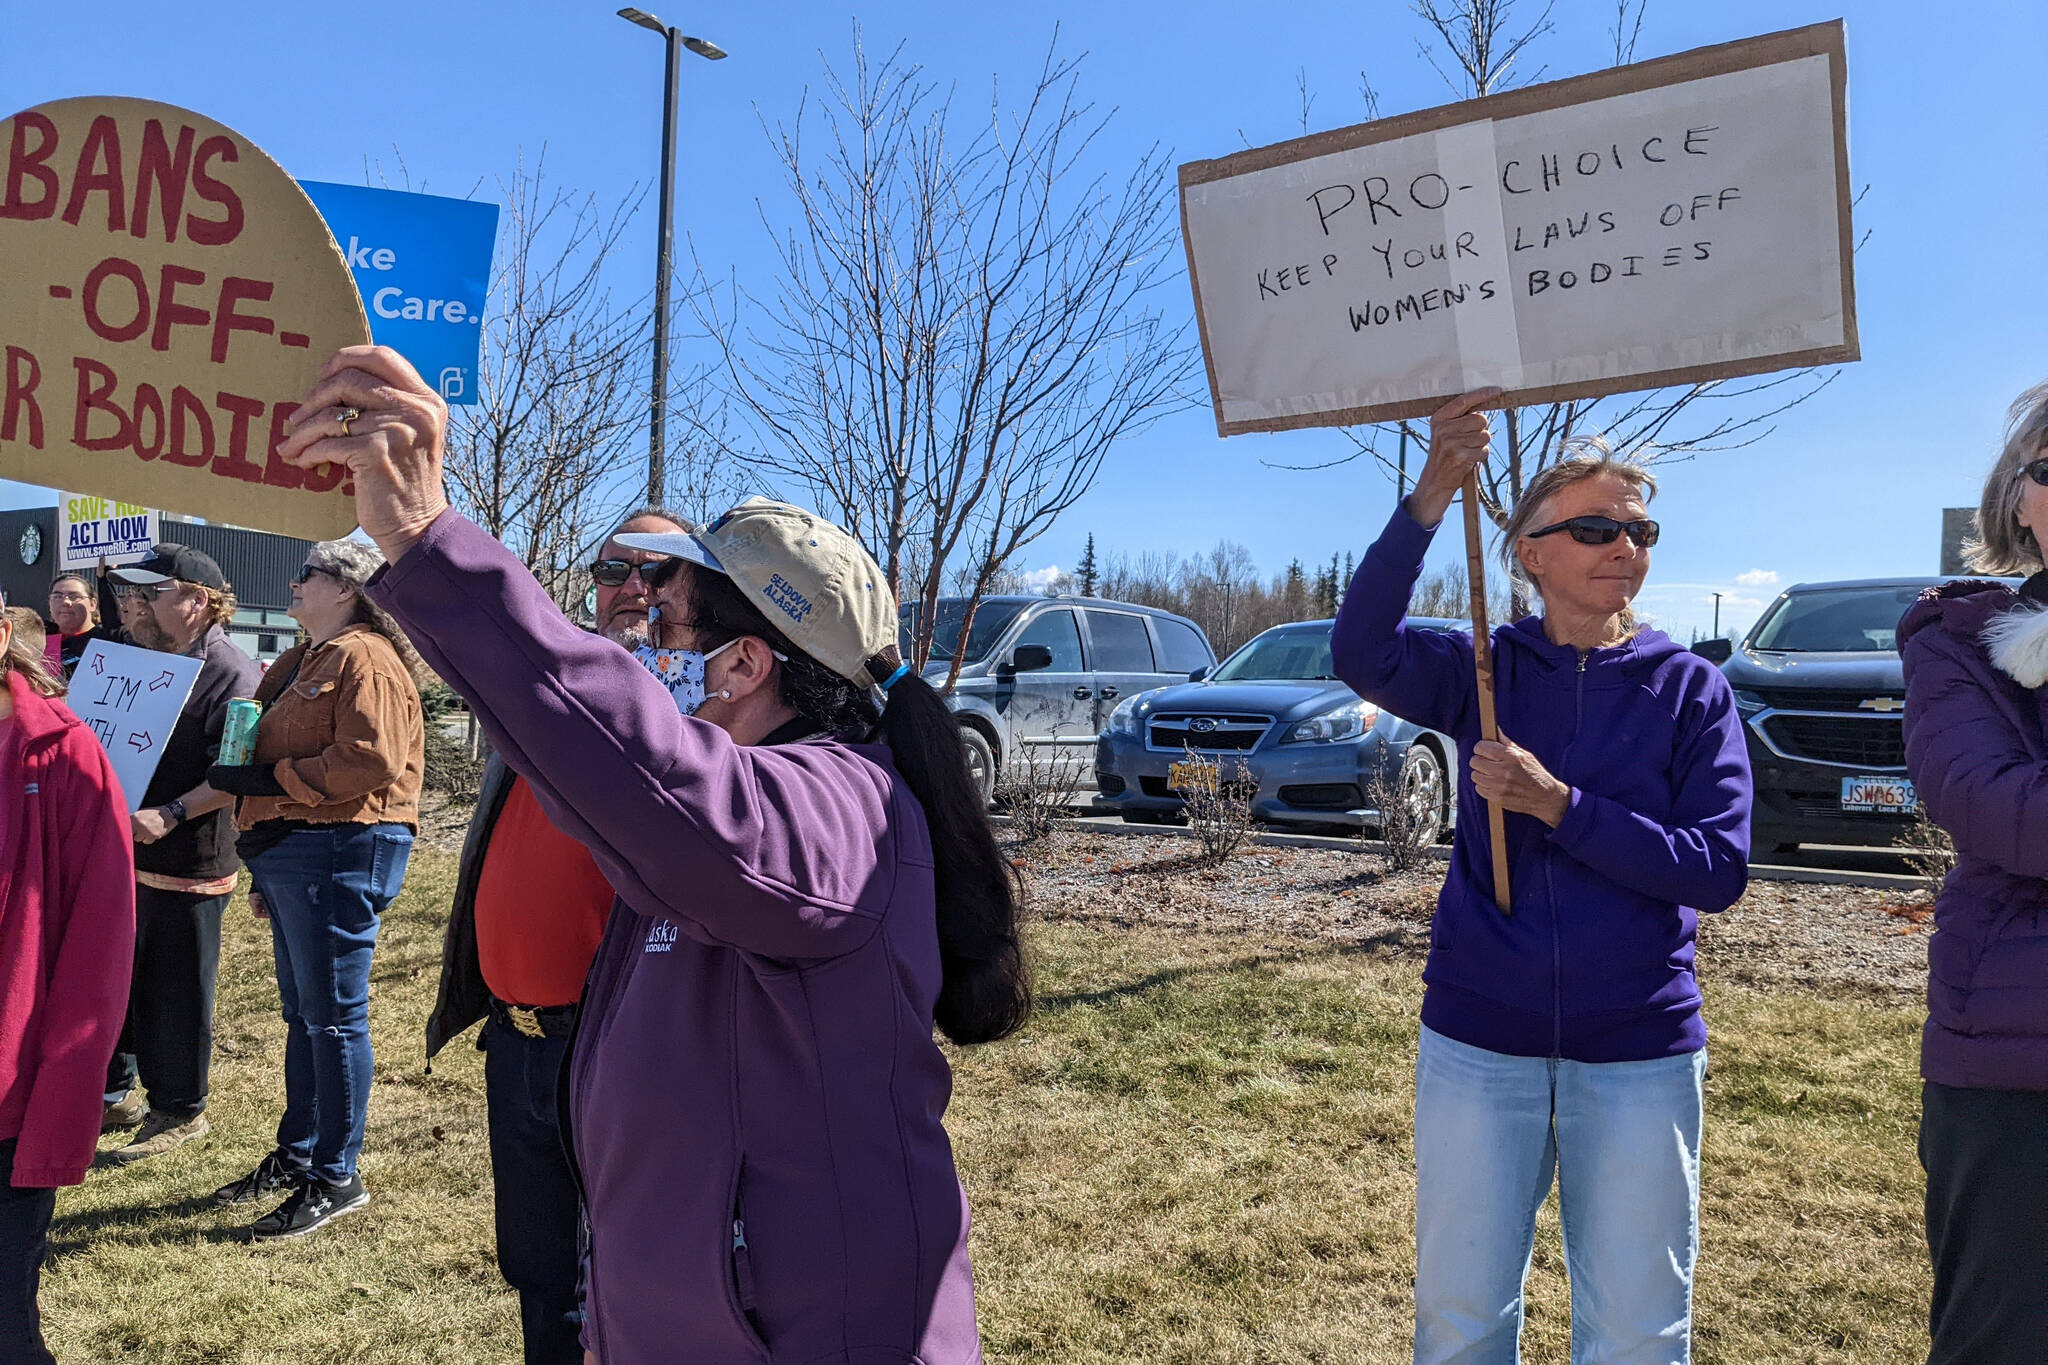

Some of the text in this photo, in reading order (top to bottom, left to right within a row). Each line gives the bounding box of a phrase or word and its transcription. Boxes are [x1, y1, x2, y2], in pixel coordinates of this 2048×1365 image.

[0, 111, 244, 246] BANS
[348, 236, 396, 271] ke
[1257, 187, 1742, 301] KEEP YOUR LAWS OFF
[373, 286, 479, 324] Care.
[1349, 242, 1712, 333] WOMEN'S BODIES
[67, 496, 109, 523] SAVE
[70, 515, 148, 546] ACT NOW
[68, 540, 150, 560] www.saveROE.com
[763, 584, 803, 623] ALASKA
[770, 573, 813, 615] SELDOVIA
[93, 675, 142, 713] I'M
[84, 717, 117, 749] TH
[645, 919, 678, 943] aska
[645, 943, 672, 953] KODIAK
